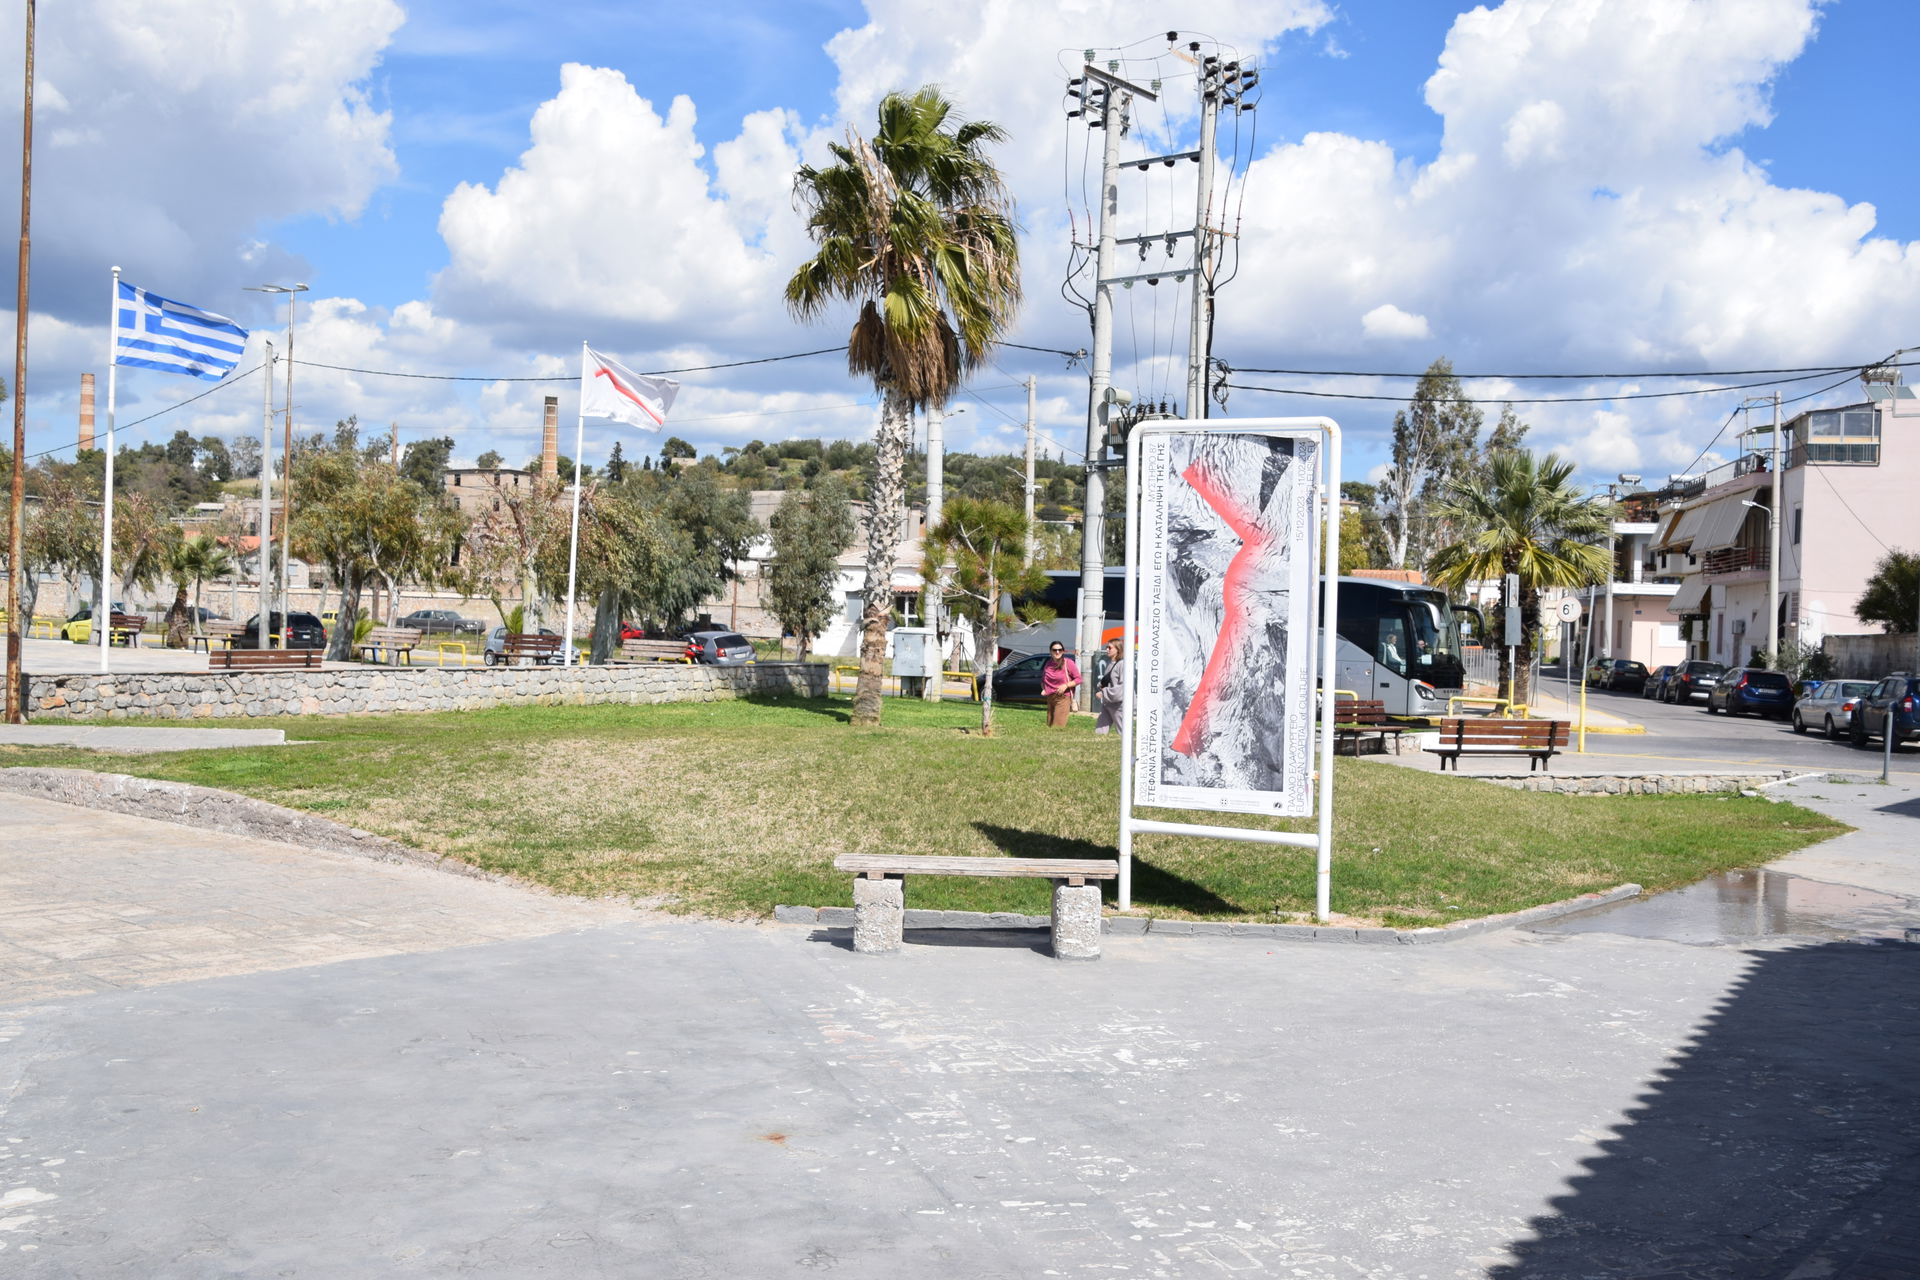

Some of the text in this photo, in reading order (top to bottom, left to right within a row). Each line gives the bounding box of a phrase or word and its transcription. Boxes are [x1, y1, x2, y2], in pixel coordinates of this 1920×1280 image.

[1156, 463, 1165, 482] ΤΗΣ
[1157, 442, 1166, 462] ΓΗΣ
[1147, 455, 1157, 503] ΜΥΣΤΗΡΙΟ
[1155, 485, 1164, 539] ΚΑΤΑΛΗΨΗ
[1295, 495, 1305, 543] 15/12/2023
[1153, 551, 1162, 571] ΕΓΩ
[1151, 608, 1160, 656] ΘΑΛΑΣΣΙΟ
[1150, 675, 1159, 694] ΕΓΩ
[1151, 659, 1159, 672] ΤΟ
[1298, 667, 1308, 710] CULTURE
[1147, 709, 1158, 803] ΣΤΕΦΑΝΙΑ ΣΤΡΟΥΖΑ
[1287, 714, 1298, 812] ΠΑΛΑΙΟ ΕΛΑΙΟΥΡΓΕΙΟ
[1298, 724, 1306, 760] CAPITAL
[1296, 762, 1305, 813] EUROPEAN
